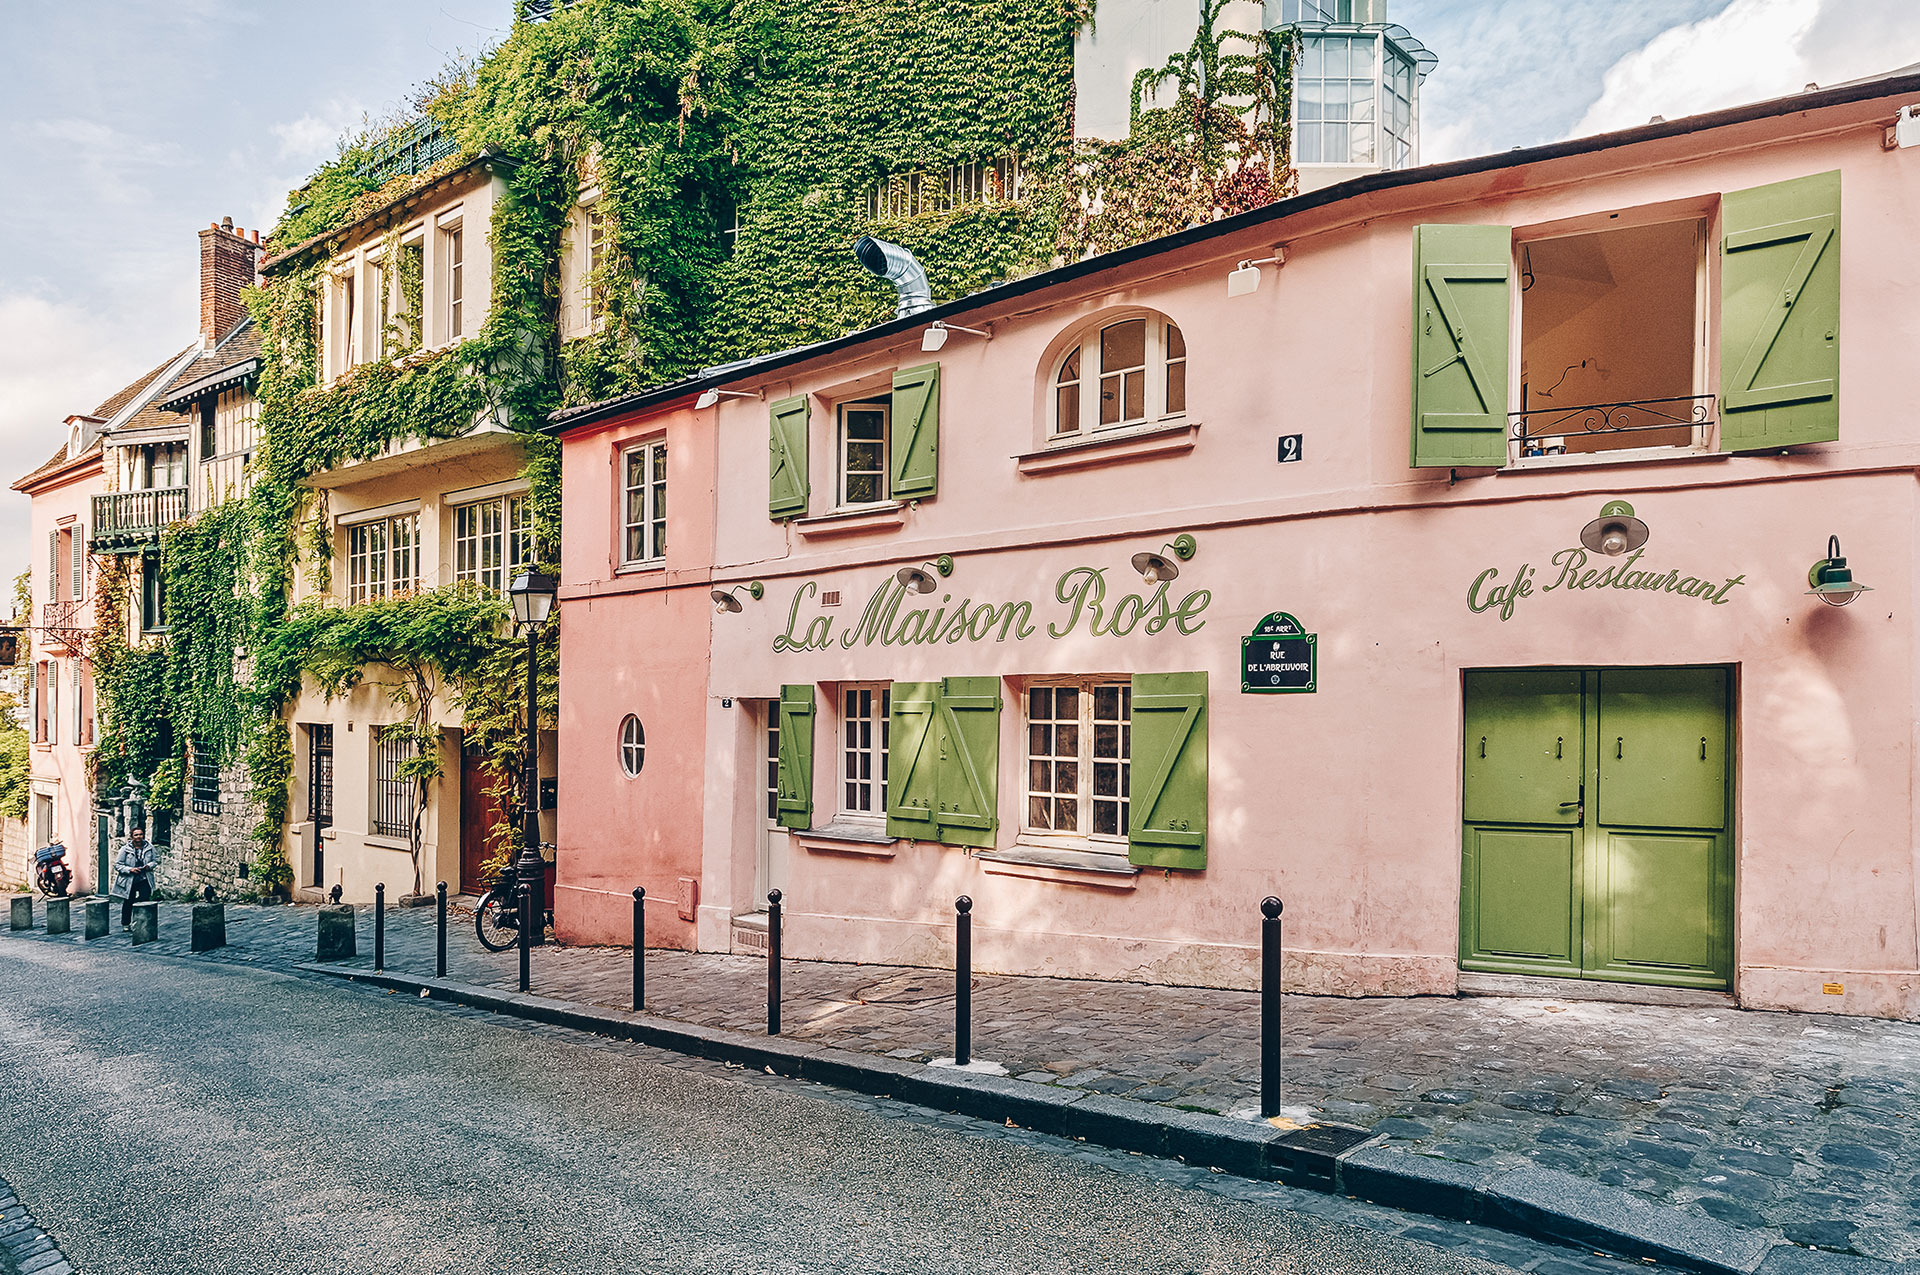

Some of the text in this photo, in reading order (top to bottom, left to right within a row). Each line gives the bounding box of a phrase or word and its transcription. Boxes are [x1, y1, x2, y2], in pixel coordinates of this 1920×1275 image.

[1283, 437, 1297, 461] 2
[1467, 547, 1746, 622] Café Restaurant
[772, 566, 1211, 653] La Maison Rose
[1247, 662, 1310, 672] DE L'ABREUVOIR
[1270, 651, 1286, 660] RUE
